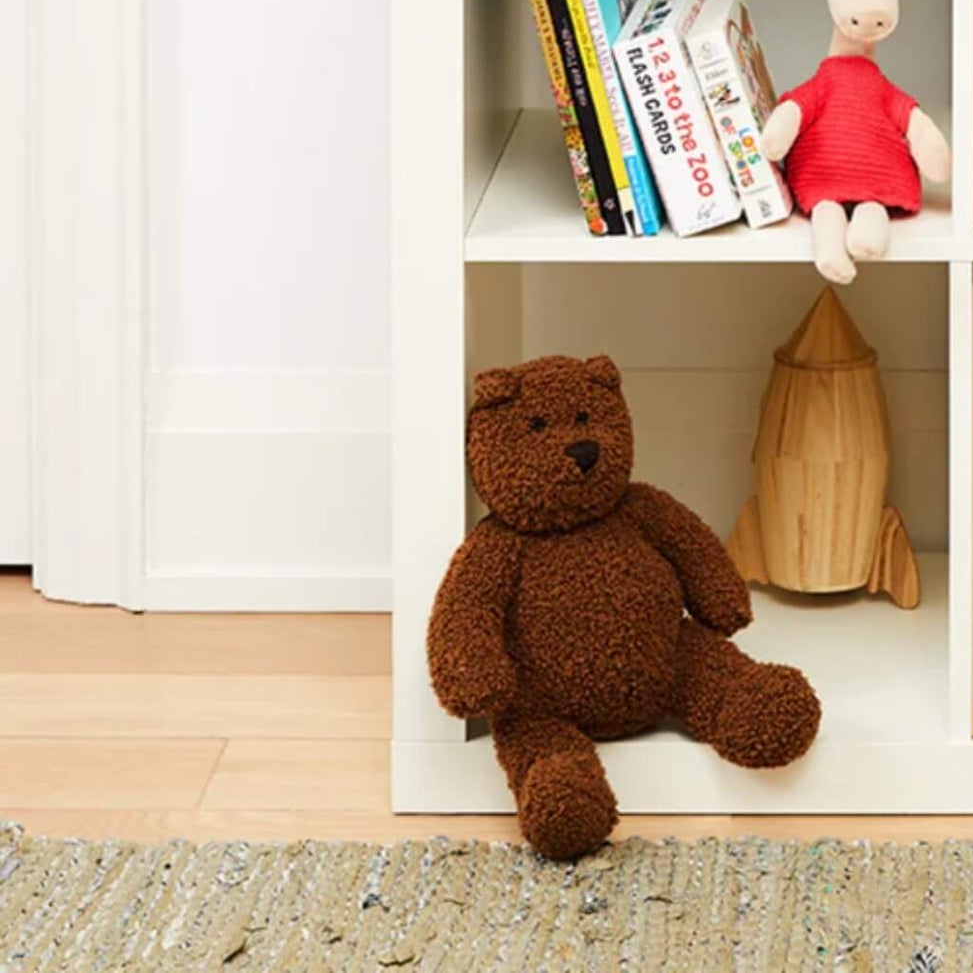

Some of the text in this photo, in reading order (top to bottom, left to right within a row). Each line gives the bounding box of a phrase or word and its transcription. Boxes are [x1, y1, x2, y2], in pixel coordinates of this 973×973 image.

[627, 47, 676, 155] FLASH CARDS
[664, 83, 682, 110] to
[674, 112, 697, 152] the
